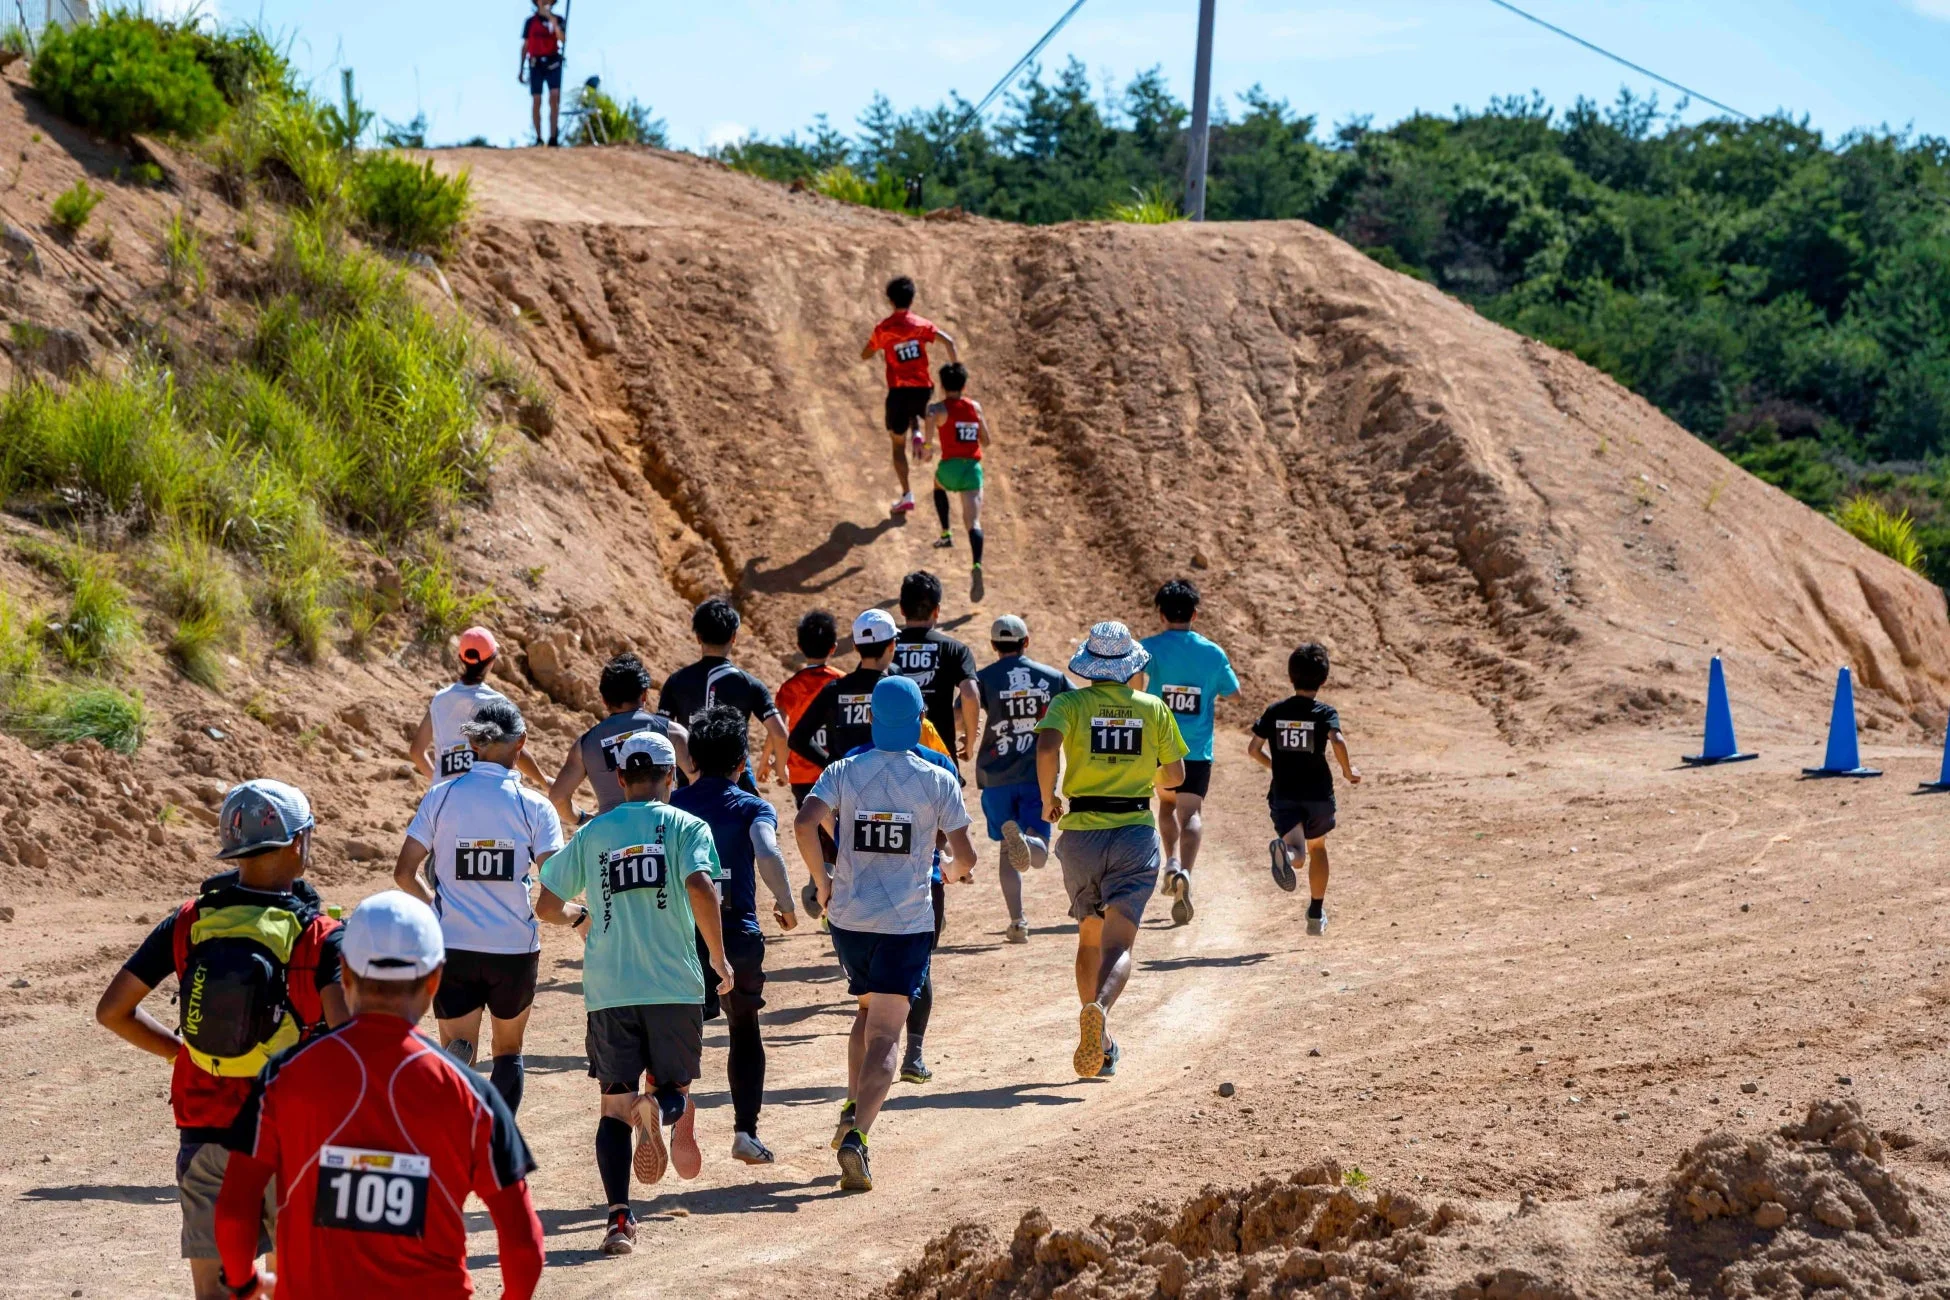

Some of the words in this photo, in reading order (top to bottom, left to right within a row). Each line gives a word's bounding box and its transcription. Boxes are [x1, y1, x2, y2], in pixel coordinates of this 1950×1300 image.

[898, 346, 919, 360] 112
[959, 428, 977, 440] 122
[899, 651, 932, 668] 106
[1006, 698, 1038, 716] 113
[1166, 694, 1196, 712] 104
[1097, 728, 1134, 750] 111
[1280, 729, 1308, 748] 151
[445, 751, 474, 772] 153
[861, 823, 904, 849] 115
[463, 850, 504, 876] 101
[615, 857, 658, 886] 110
[330, 1172, 414, 1226] 109
